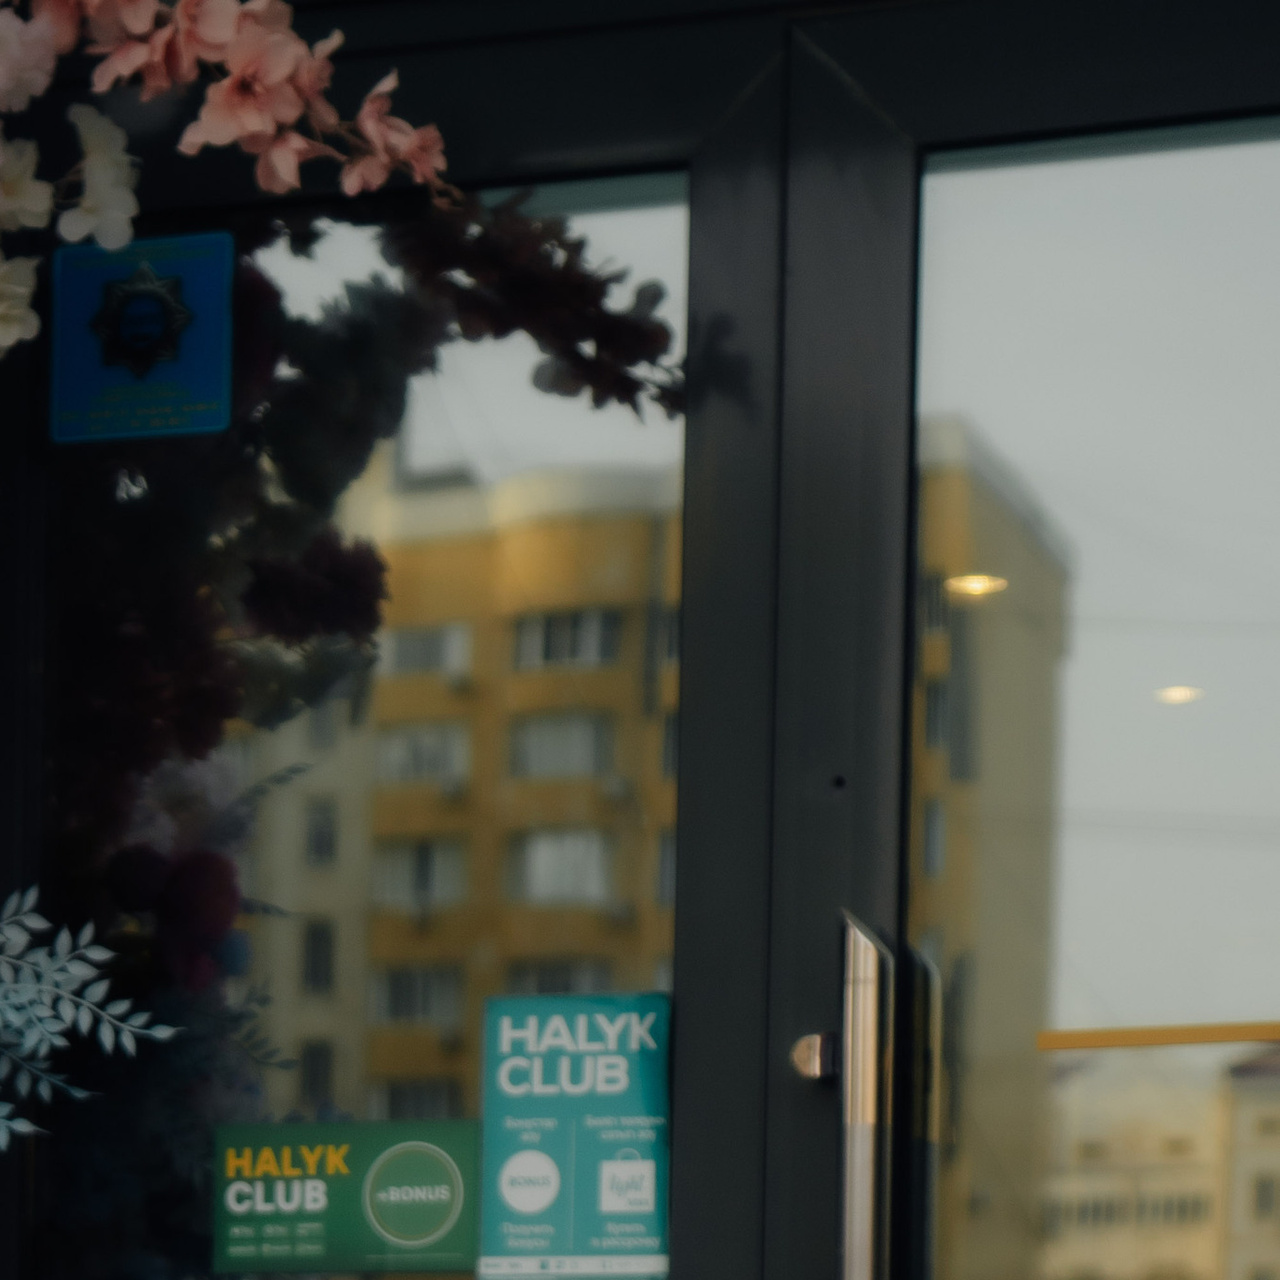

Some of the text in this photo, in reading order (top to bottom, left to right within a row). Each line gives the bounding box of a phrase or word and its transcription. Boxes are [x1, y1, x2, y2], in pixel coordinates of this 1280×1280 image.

[499, 1012, 657, 1053] HALYK
[497, 1055, 630, 1096] CLUB
[226, 1144, 350, 1178] HALYK
[226, 1180, 329, 1213] CLUB
